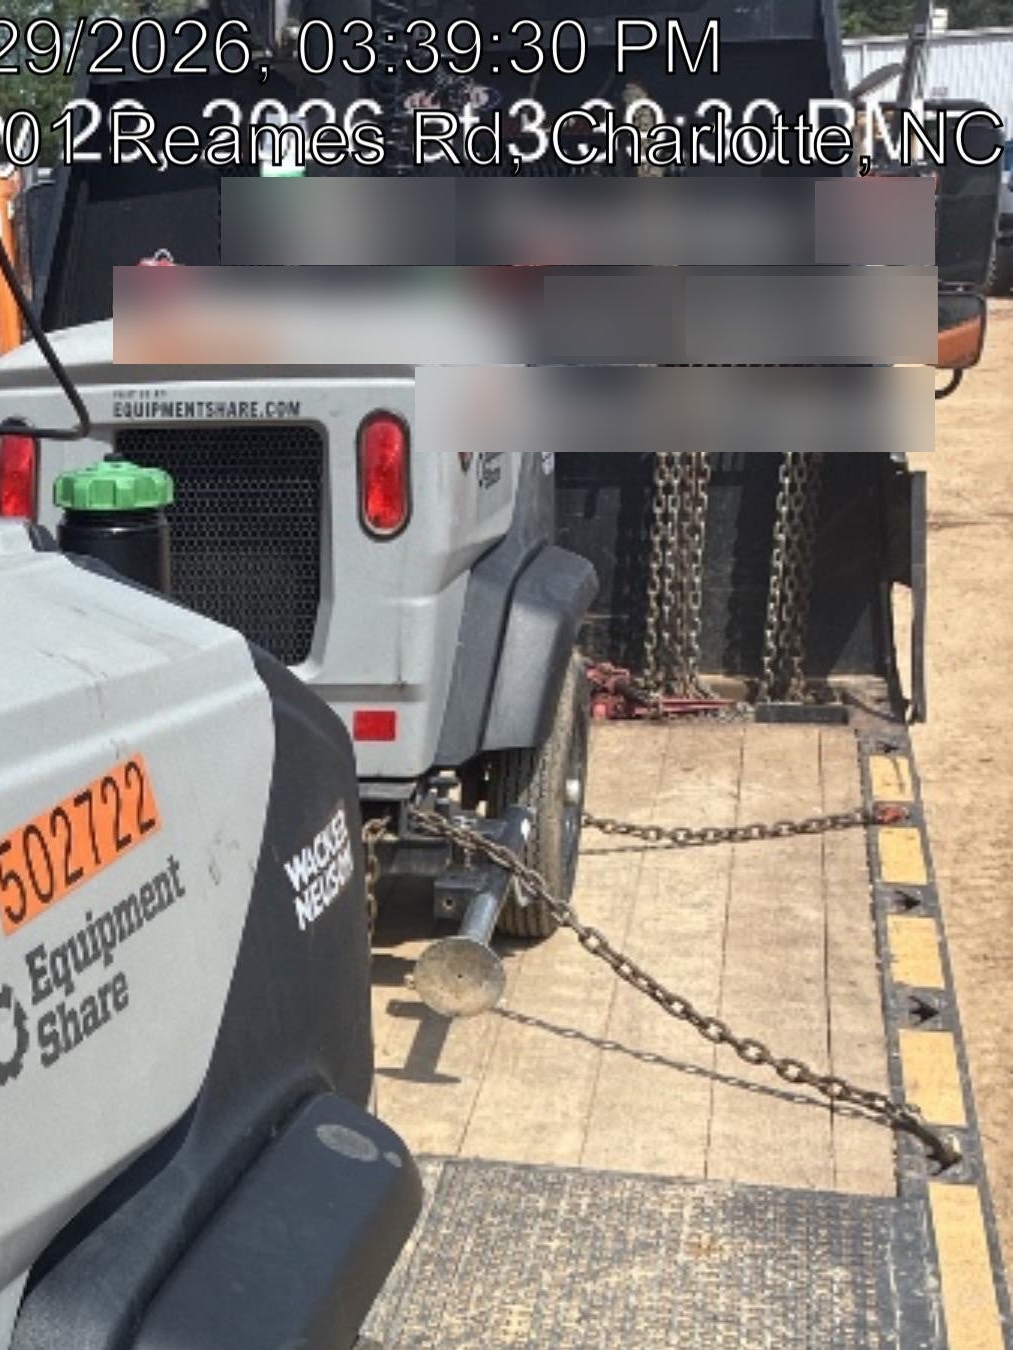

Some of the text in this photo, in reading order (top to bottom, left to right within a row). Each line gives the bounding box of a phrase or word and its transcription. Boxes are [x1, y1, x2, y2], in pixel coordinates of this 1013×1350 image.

[112, 400, 301, 419] EQUIPMENTSHARE.COM
[283, 807, 349, 892] WACKER
[293, 838, 354, 931] NEUSON
[25, 854, 186, 1005] Equipment
[36, 971, 130, 1068] Share
